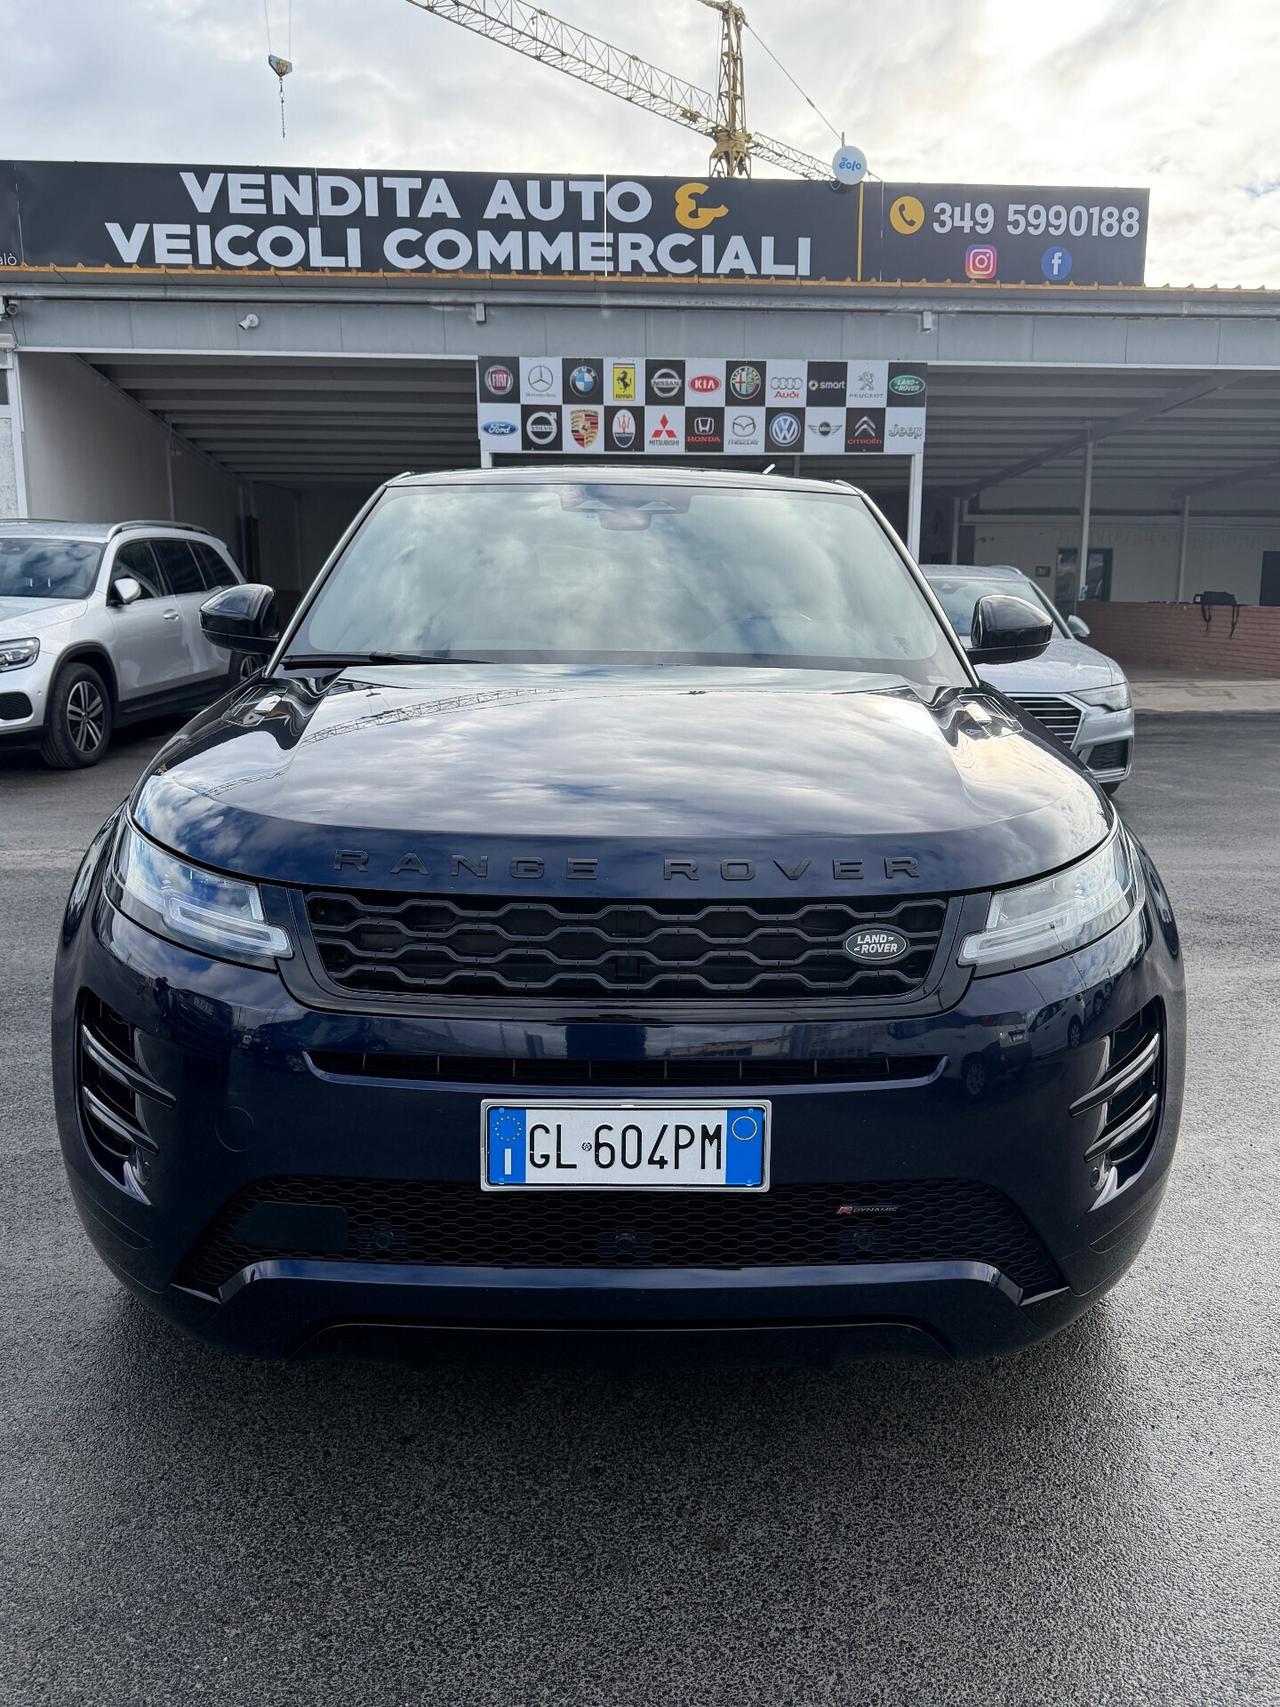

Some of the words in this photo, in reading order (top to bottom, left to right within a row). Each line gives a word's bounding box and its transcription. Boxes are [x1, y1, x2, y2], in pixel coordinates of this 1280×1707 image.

[179, 172, 460, 218] VENDITA
[483, 179, 652, 223] AUTO
[675, 183, 729, 229] &
[933, 202, 995, 234] 349
[1007, 204, 1140, 238] 5990188
[105, 223, 361, 268] VEICOLI
[383, 228, 811, 276] COMMERCIALI
[492, 374, 507, 387] FIAT
[695, 380, 716, 389] KIA
[820, 381, 845, 389] smart
[774, 391, 799, 399] Audi
[489, 423, 512, 434] Ford
[333, 849, 600, 881] RANGE
[664, 856, 920, 882] ROVER
[857, 934, 887, 944] LAND
[861, 943, 898, 954] ROVER
[529, 1123, 577, 1169] GL
[594, 1124, 722, 1170] 604PM
